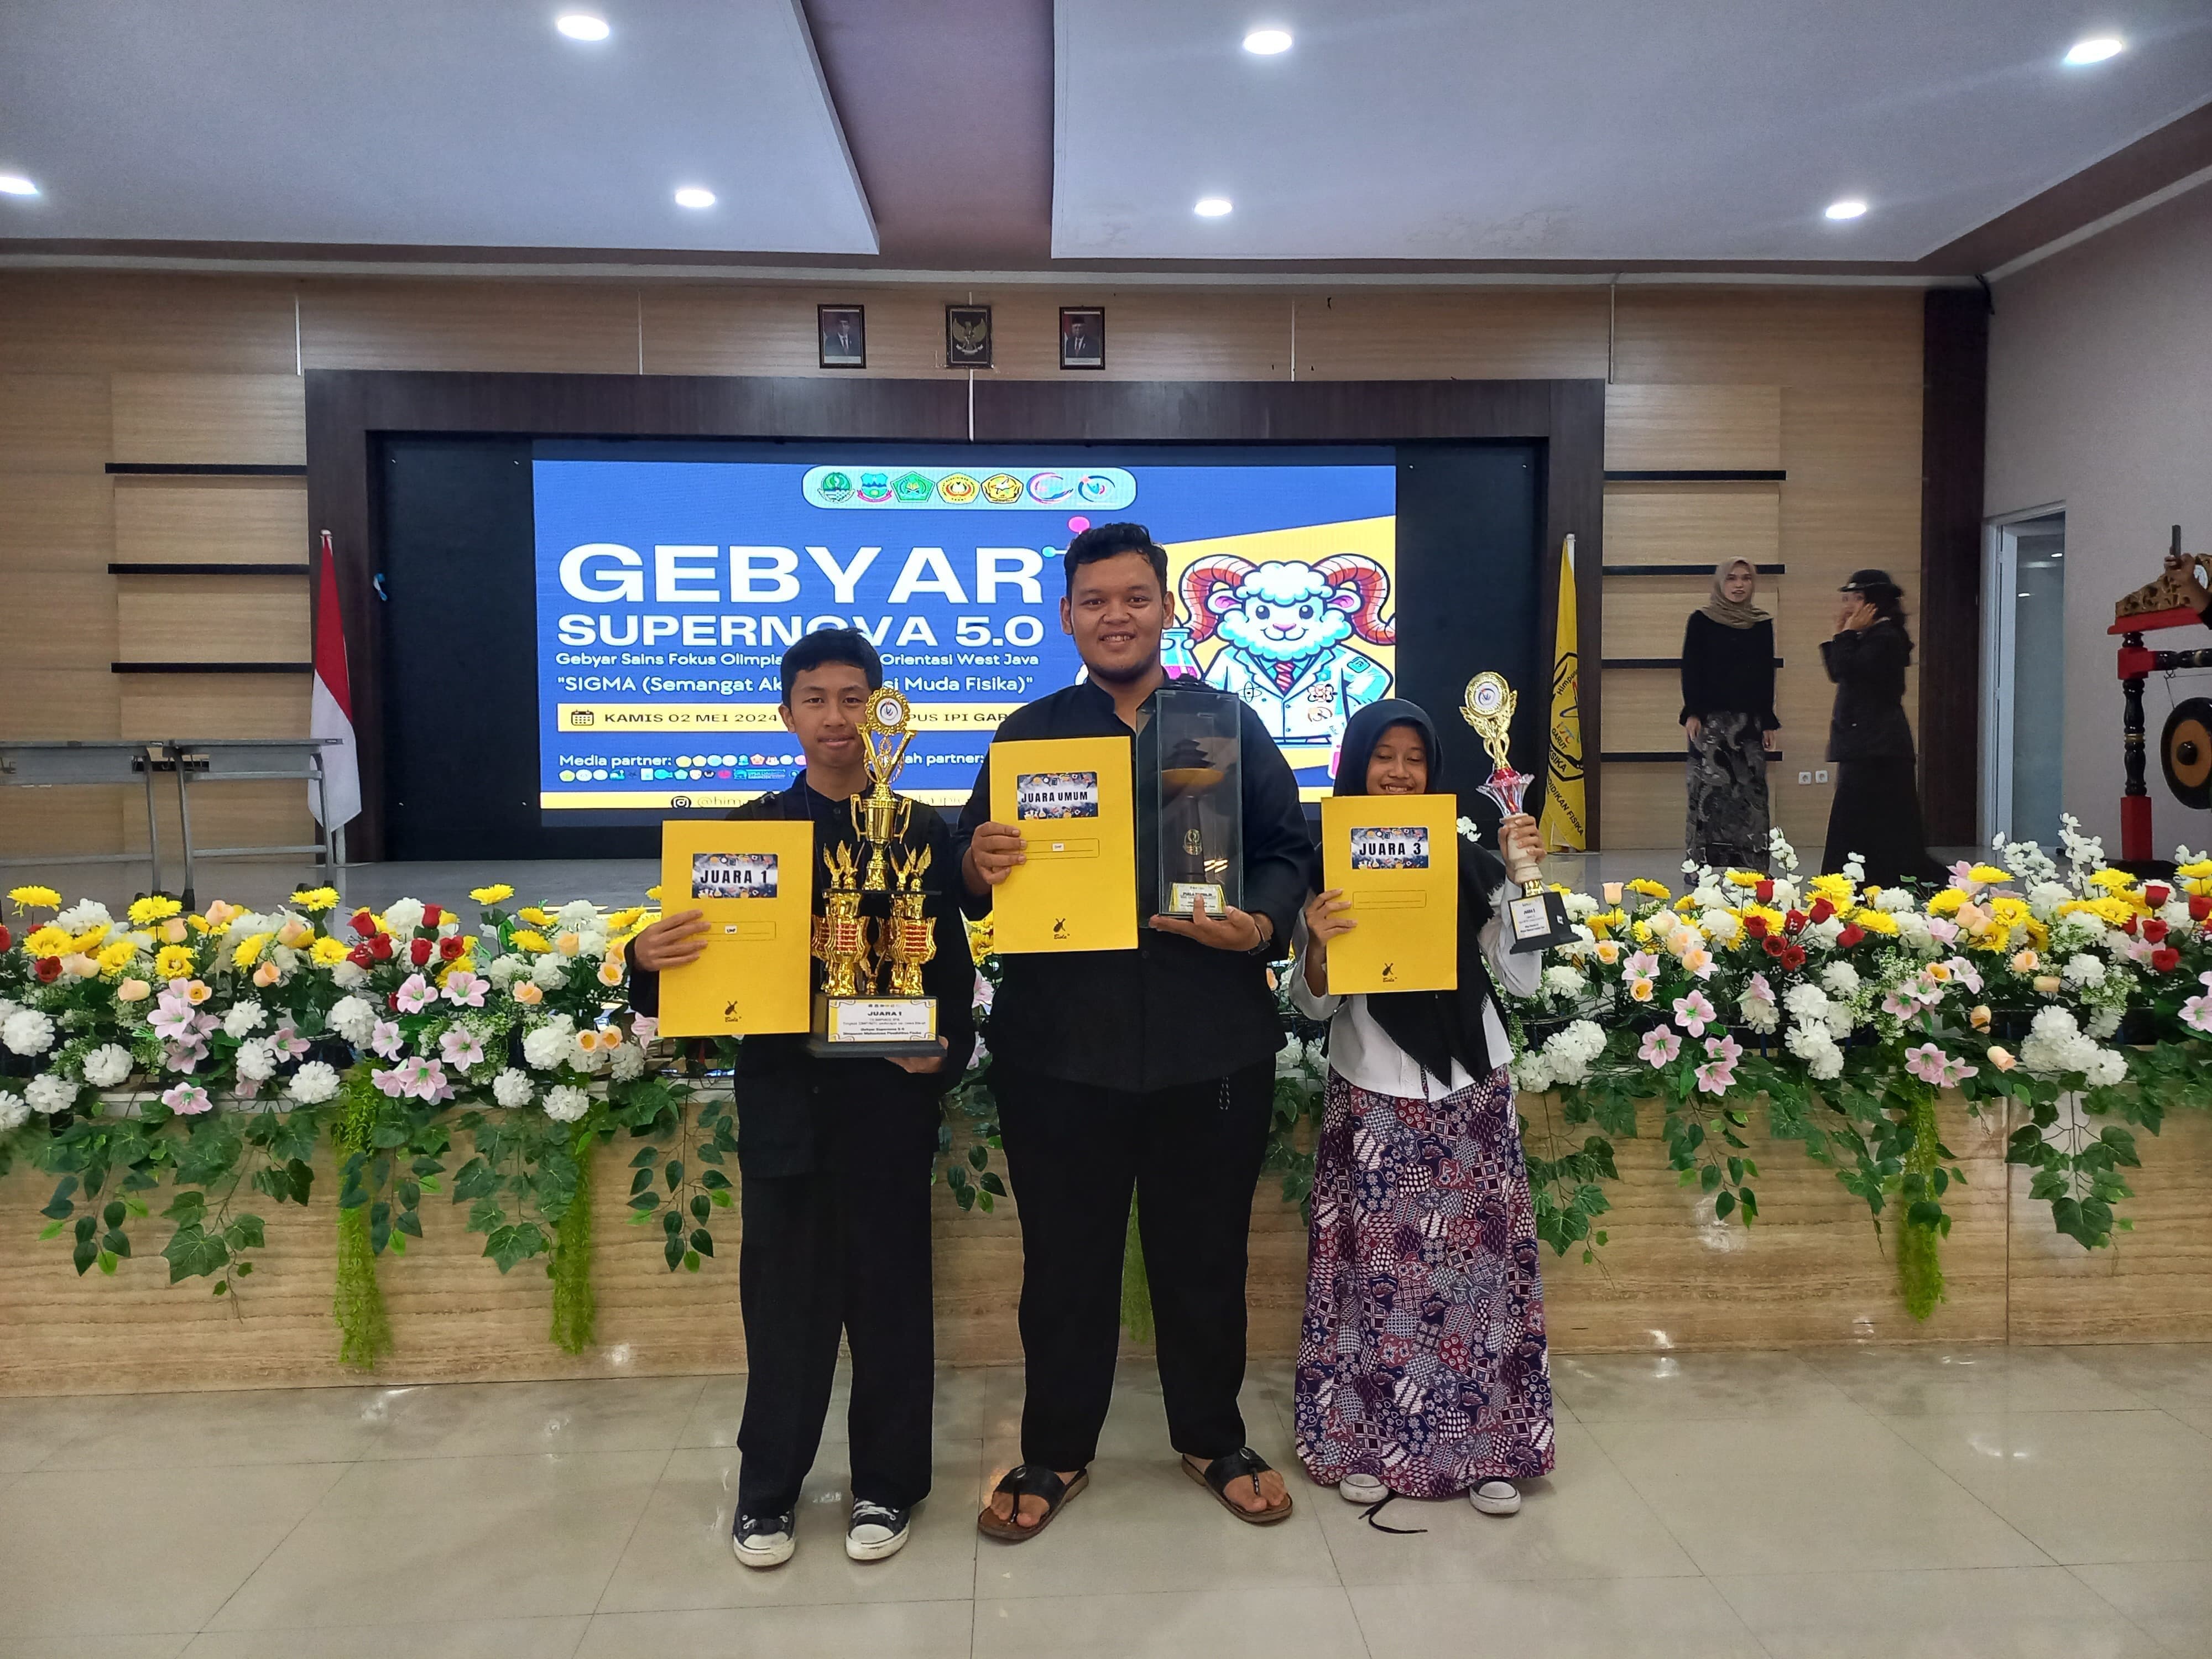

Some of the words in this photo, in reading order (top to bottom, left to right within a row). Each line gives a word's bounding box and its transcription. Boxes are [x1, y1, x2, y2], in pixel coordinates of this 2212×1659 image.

[559, 542, 1044, 603] GEBYAR
[956, 615, 1045, 646] 5.0
[556, 653, 617, 668] Gebyar
[621, 653, 664, 665] Sains
[669, 653, 716, 665] Fokus
[880, 653, 953, 665] Orientasi
[957, 653, 1000, 665] West
[1004, 654, 1039, 665] Java
[557, 676, 636, 691] "SIGMA
[642, 676, 754, 695] (Semangat
[905, 677, 959, 691] Muda
[966, 676, 1034, 693] Fisika)"
[605, 713, 663, 722] KAMIS
[669, 713, 690, 722] 02
[696, 713, 728, 722] MEI
[735, 713, 777, 722] 2024
[1552, 728, 1567, 750] GARUT
[560, 754, 607, 766] Media
[612, 755, 672, 768] partner:
[926, 753, 984, 767] partner:
[1021, 792, 1055, 804] JUARA
[1058, 791, 1088, 801] UMUM
[1567, 811, 1584, 837] FISIKA
[1359, 842, 1406, 856] JUARA
[1413, 842, 1421, 855] 3
[700, 870, 752, 884] JUARA
[761, 870, 768, 884] 1
